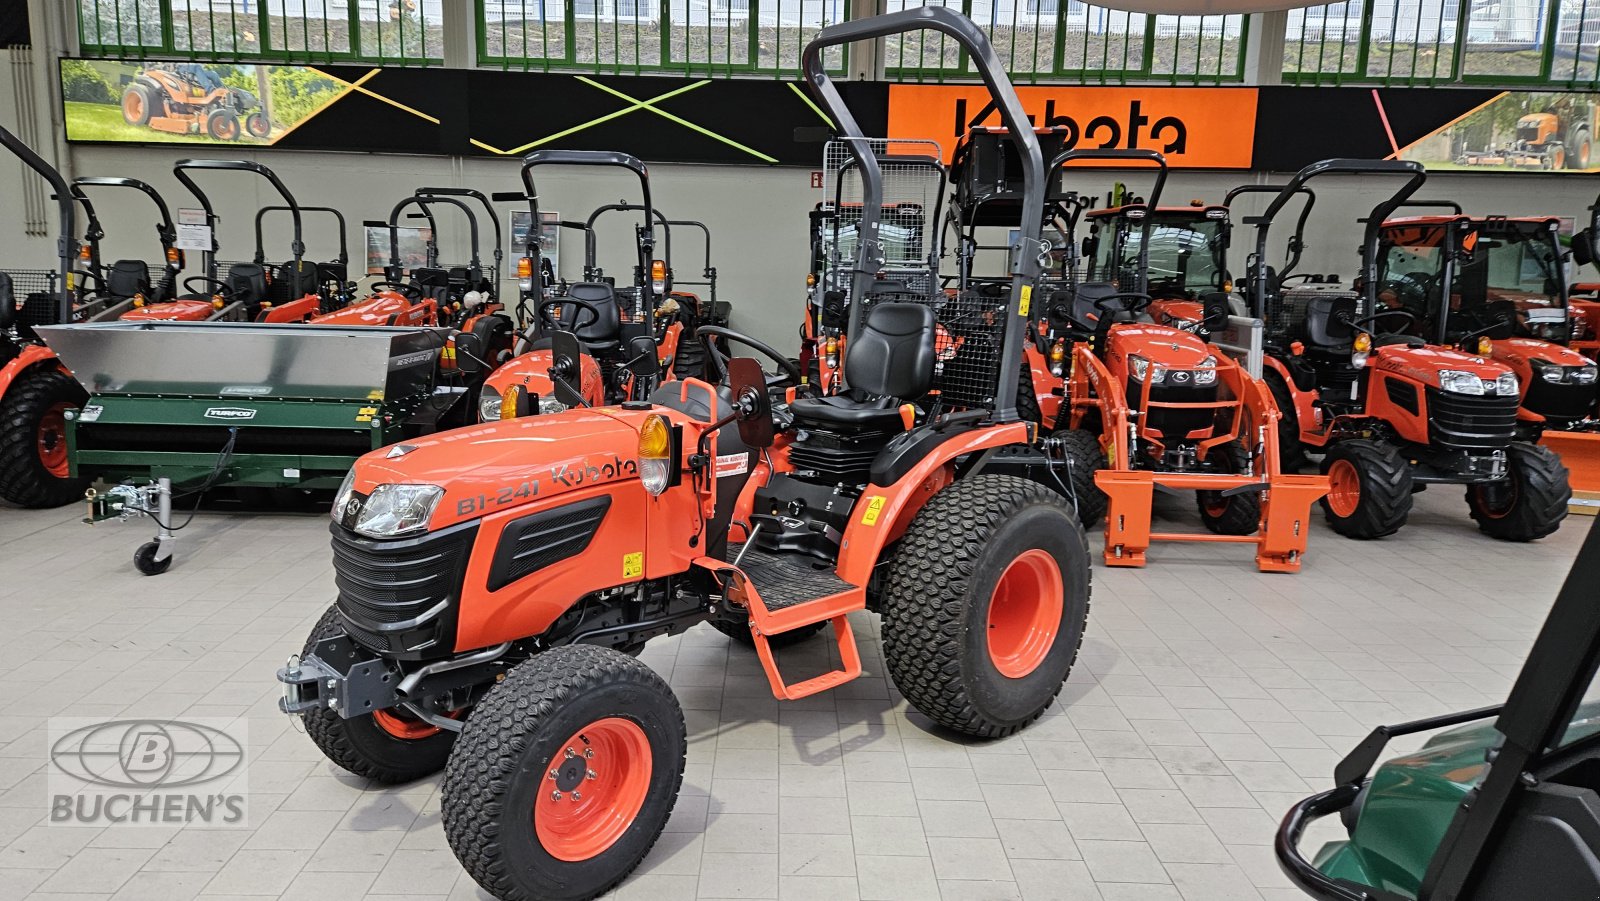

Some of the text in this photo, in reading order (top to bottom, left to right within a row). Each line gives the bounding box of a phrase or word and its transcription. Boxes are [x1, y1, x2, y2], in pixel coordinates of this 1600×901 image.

[955, 98, 1187, 155] Kbota
[209, 409, 253, 418] TURFCO
[456, 455, 637, 517] B1-241 Kubota
